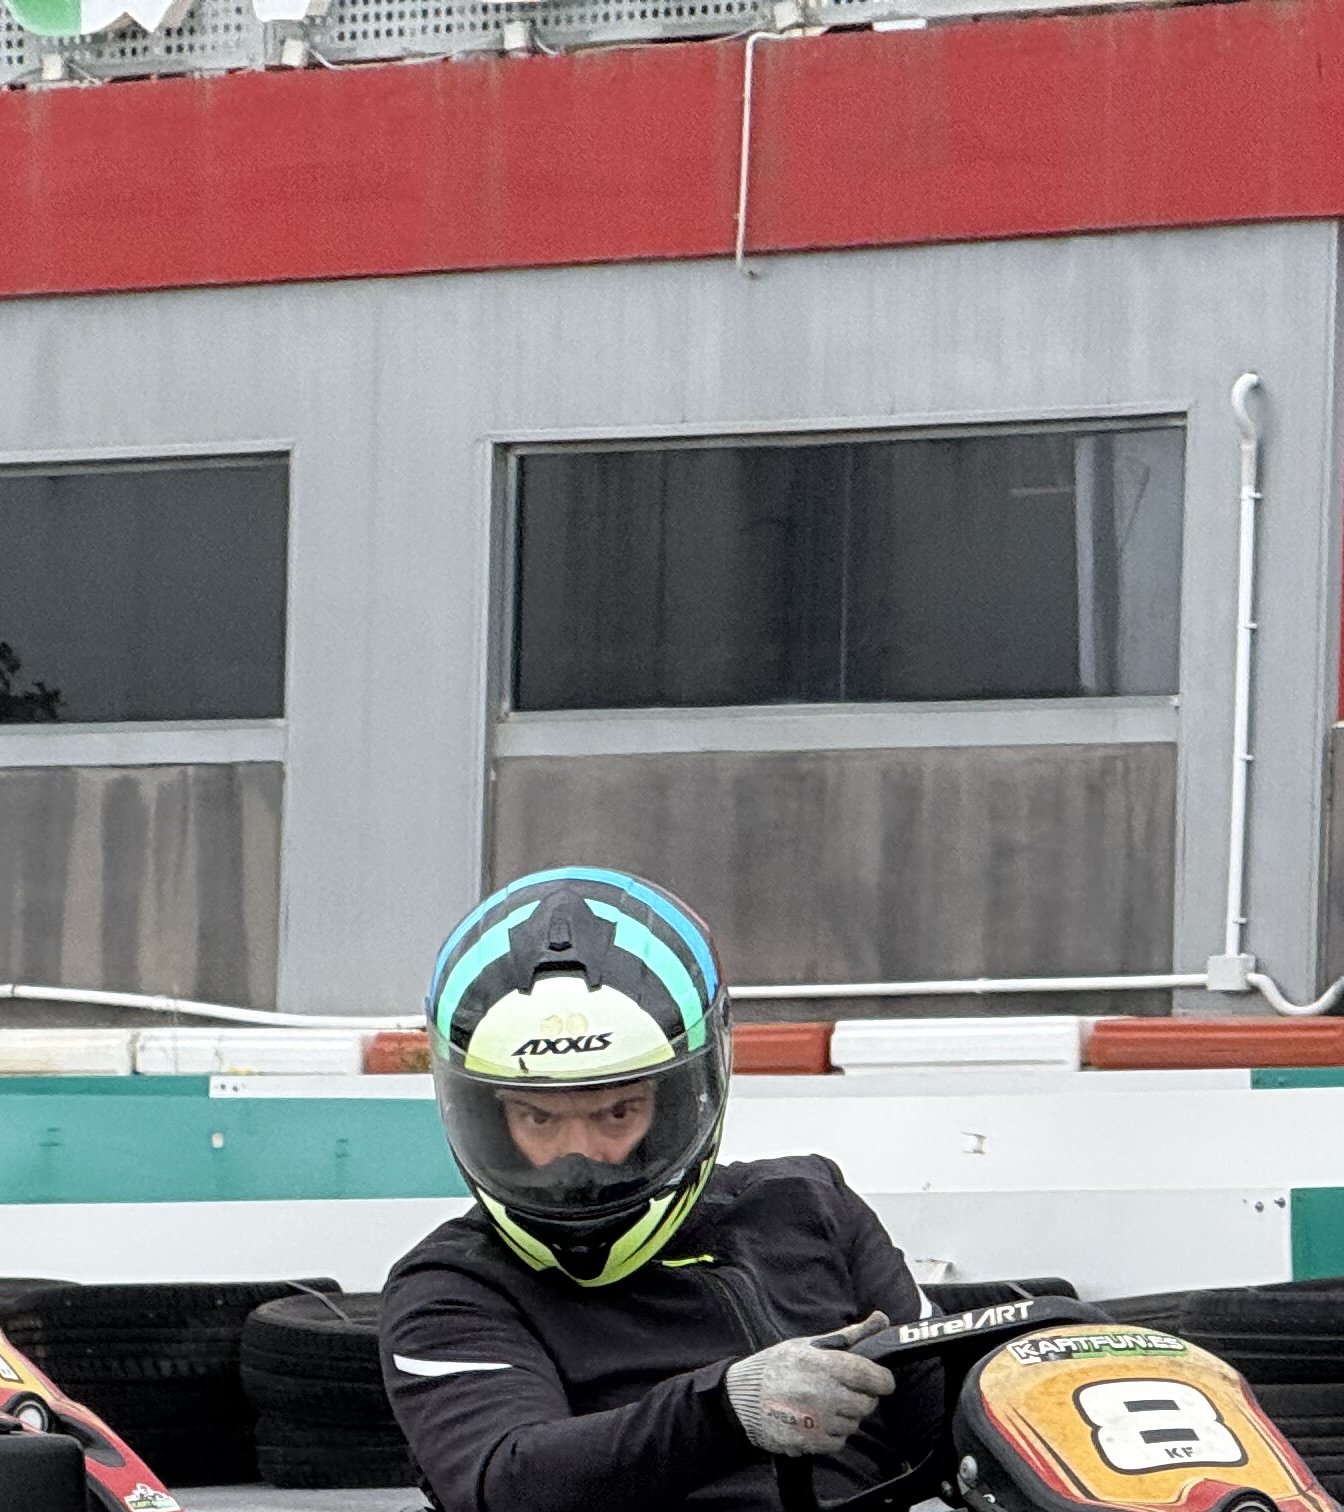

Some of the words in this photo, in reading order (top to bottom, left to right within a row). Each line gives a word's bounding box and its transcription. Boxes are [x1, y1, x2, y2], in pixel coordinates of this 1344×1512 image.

[511, 1032, 614, 1056] AXXIS
[899, 1301, 1035, 1344] birelART
[1017, 1335, 1185, 1358] KARTFUN.ES
[1072, 1377, 1249, 1475] 8
[1164, 1446, 1195, 1459] KF
